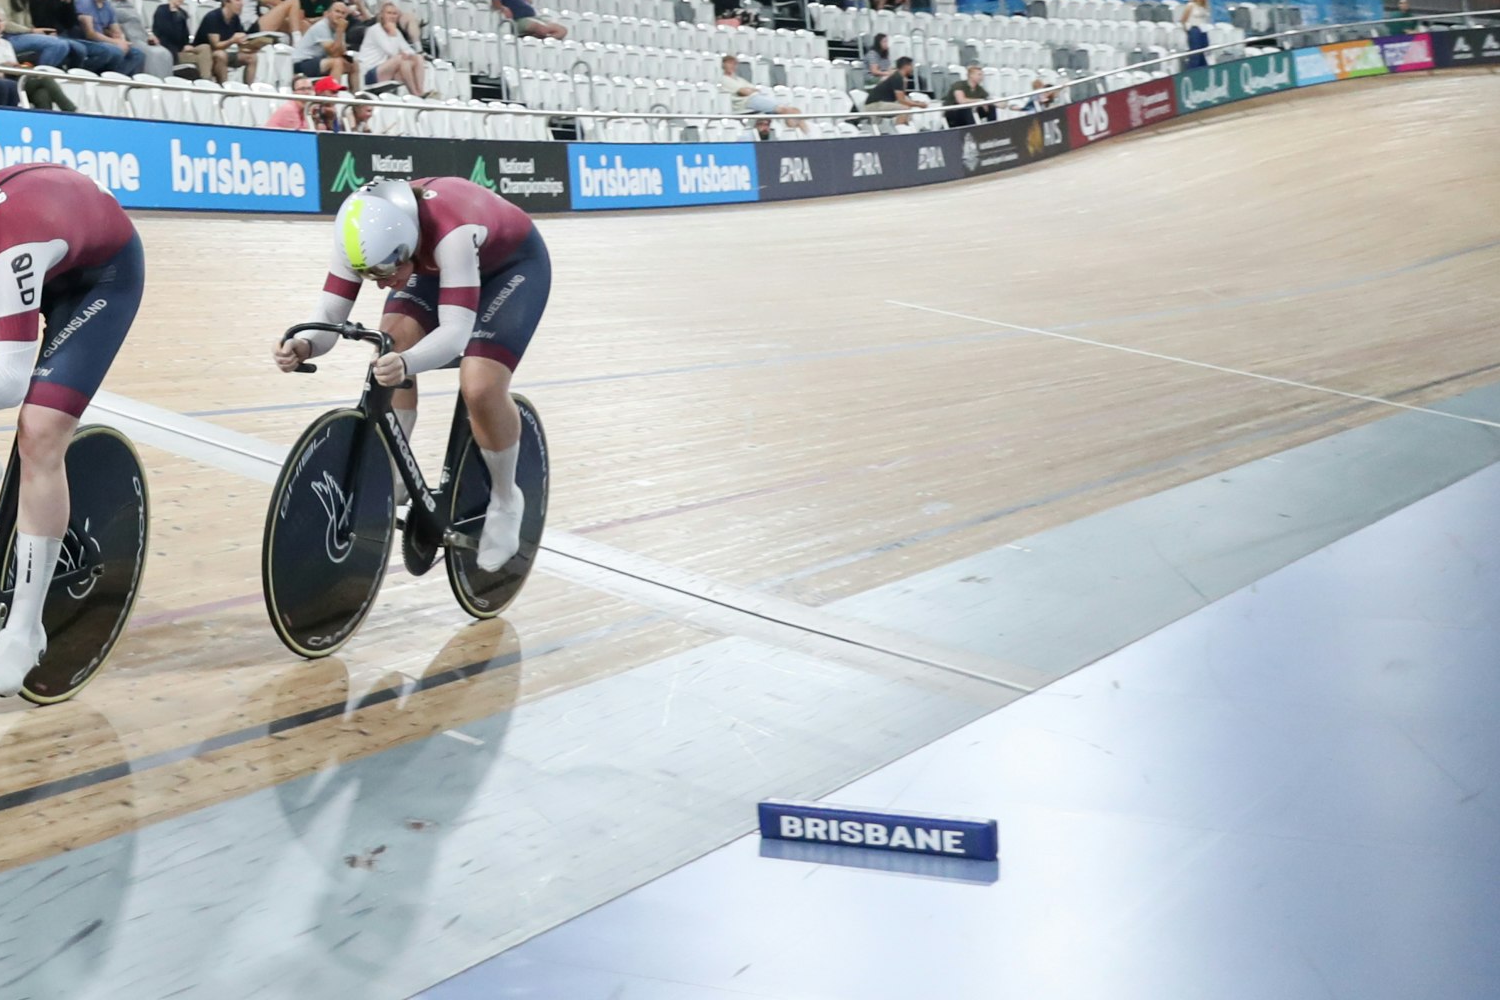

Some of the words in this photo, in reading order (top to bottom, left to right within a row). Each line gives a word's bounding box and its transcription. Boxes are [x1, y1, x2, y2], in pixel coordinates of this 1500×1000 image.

[171, 139, 306, 197] brisbane
[371, 154, 413, 172] National
[499, 157, 535, 174] National
[579, 155, 663, 197] brisbane
[676, 154, 751, 193] brisbane
[500, 177, 564, 197] Championships
[11, 253, 35, 306] QLD
[481, 274, 526, 323] QUEENSLAND
[44, 298, 108, 358] QUEENSLAND
[385, 412, 422, 490] ARGON
[780, 815, 966, 854] BRISBANE
